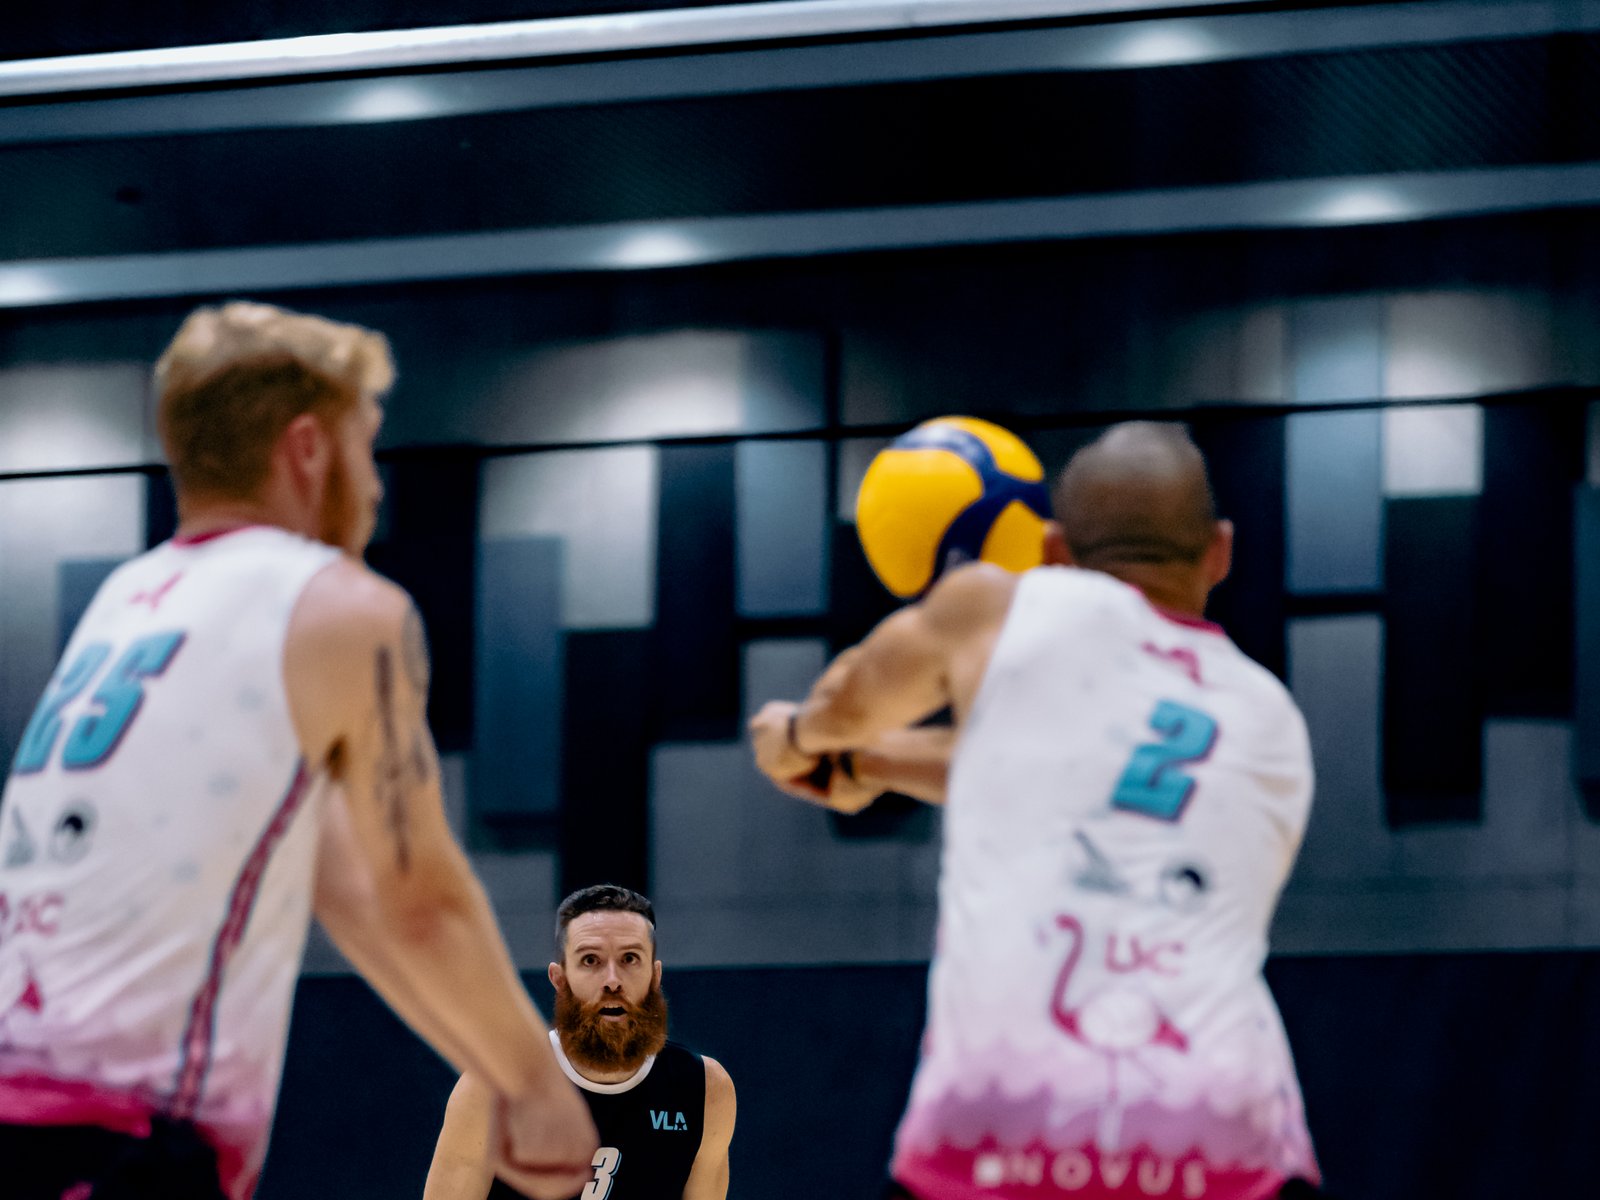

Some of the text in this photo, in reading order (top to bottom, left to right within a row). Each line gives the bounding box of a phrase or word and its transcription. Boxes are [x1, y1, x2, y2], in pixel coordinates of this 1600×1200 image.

[1110, 698, 1219, 824] 2
[649, 1109, 688, 1131] VLA
[1000, 1150, 1206, 1200] NOVUS
